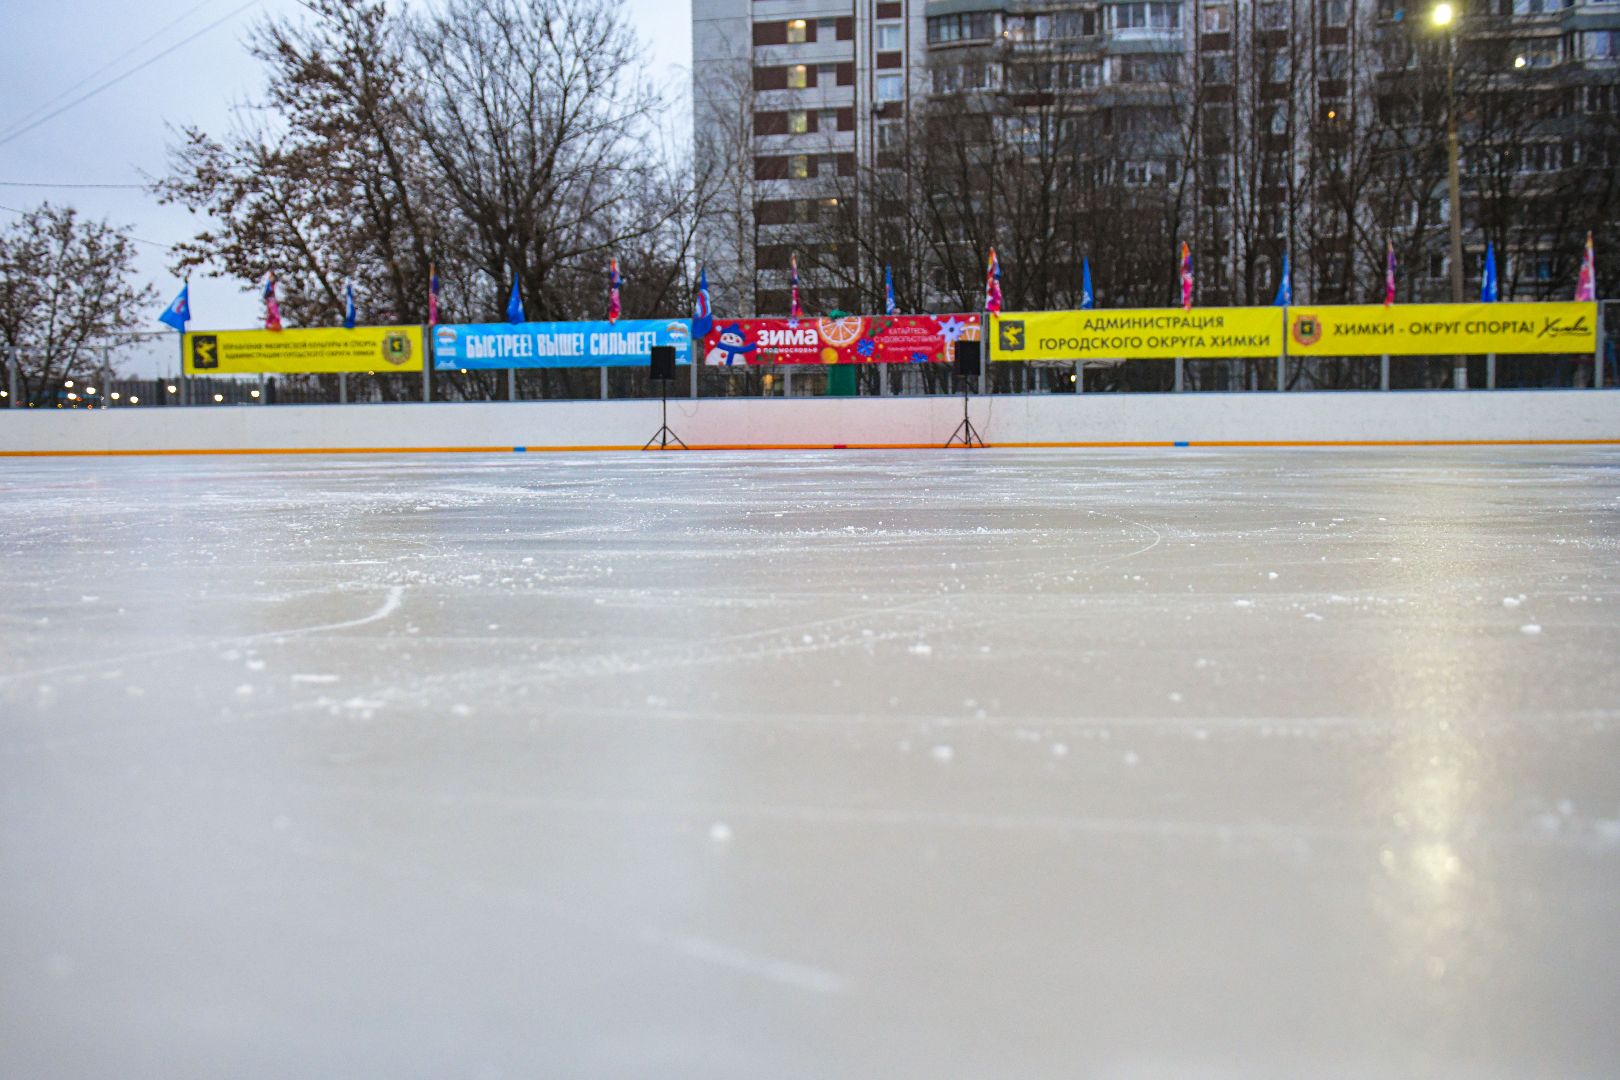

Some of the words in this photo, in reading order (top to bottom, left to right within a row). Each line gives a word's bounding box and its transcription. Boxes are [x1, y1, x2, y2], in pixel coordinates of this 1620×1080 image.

[1083, 316, 1224, 331] АДМИНИСТРАЦИЯ
[1333, 322, 1394, 335] ХИМКИ
[1408, 321, 1460, 335] ОКРУГ
[1465, 321, 1535, 335] СПОРТА!
[466, 333, 532, 358] БЫСТРЕЕ!
[537, 332, 584, 357] ВЫШЕ!
[590, 331, 657, 356] СИЛЬНЕЕ!
[1039, 336, 1142, 351] ГОРОДСКОГО
[1147, 335, 1206, 348] ОКРУГА
[1210, 334, 1270, 347] ХИМКИ
